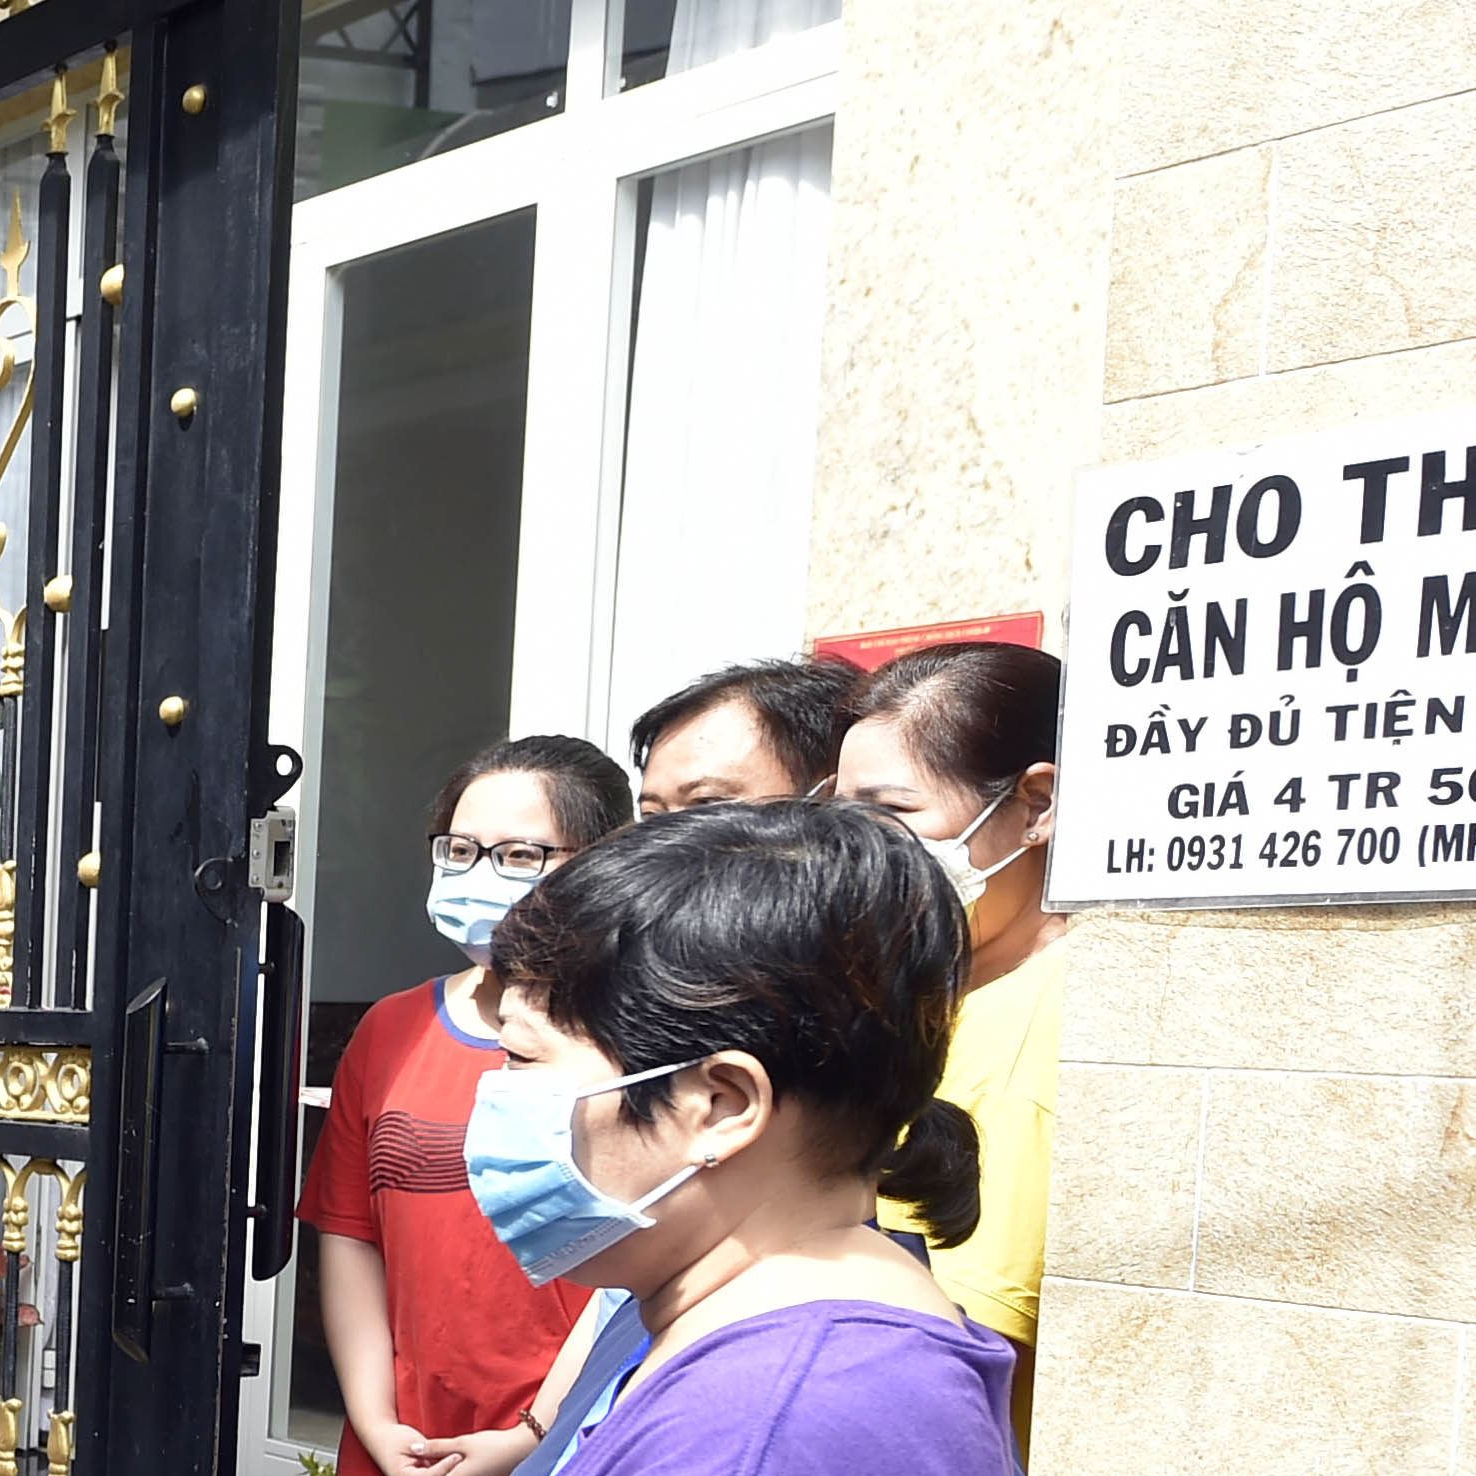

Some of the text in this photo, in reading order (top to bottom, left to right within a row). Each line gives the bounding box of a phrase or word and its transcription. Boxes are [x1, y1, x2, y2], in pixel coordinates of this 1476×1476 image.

[1105, 475, 1302, 577] CHO
[1109, 588, 1248, 688] CĂN
[1277, 560, 1382, 683] HỘ
[1104, 689, 1465, 758] ĐẦY ĐỦ TIỆN
[1167, 766, 1476, 820] GIÁ 4 TR 5
[1107, 838, 1155, 874] LH:
[1167, 833, 1243, 872] 0931
[1258, 829, 1322, 869] 426
[1337, 826, 1401, 866] 700
